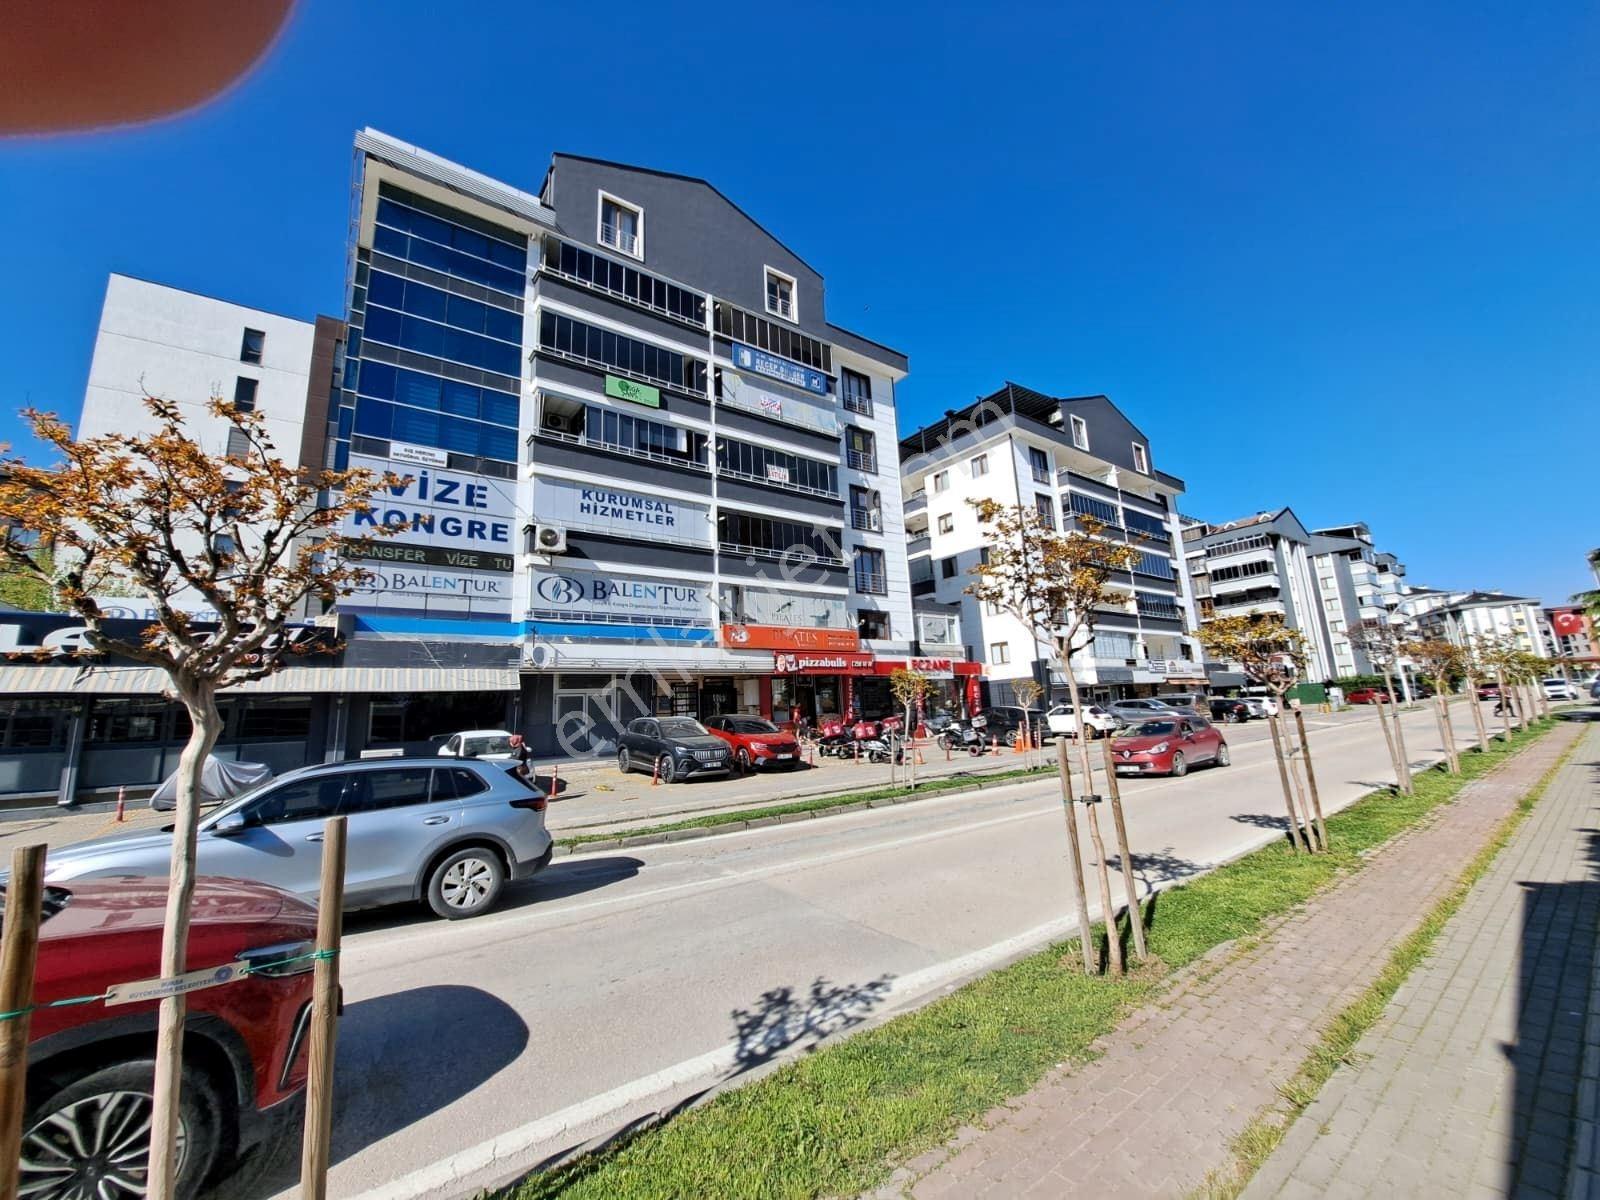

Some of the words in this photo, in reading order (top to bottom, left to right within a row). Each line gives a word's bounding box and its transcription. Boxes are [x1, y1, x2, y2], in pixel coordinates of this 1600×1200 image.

[387, 471, 488, 508] VİZE
[582, 490, 673, 513] KURUMSAL
[354, 507, 508, 542] KONGRE
[580, 503, 674, 526] HİZMETLER
[446, 552, 480, 567] VİZE
[799, 656, 847, 669] pizzabulls
[911, 659, 953, 671] ECZANE
